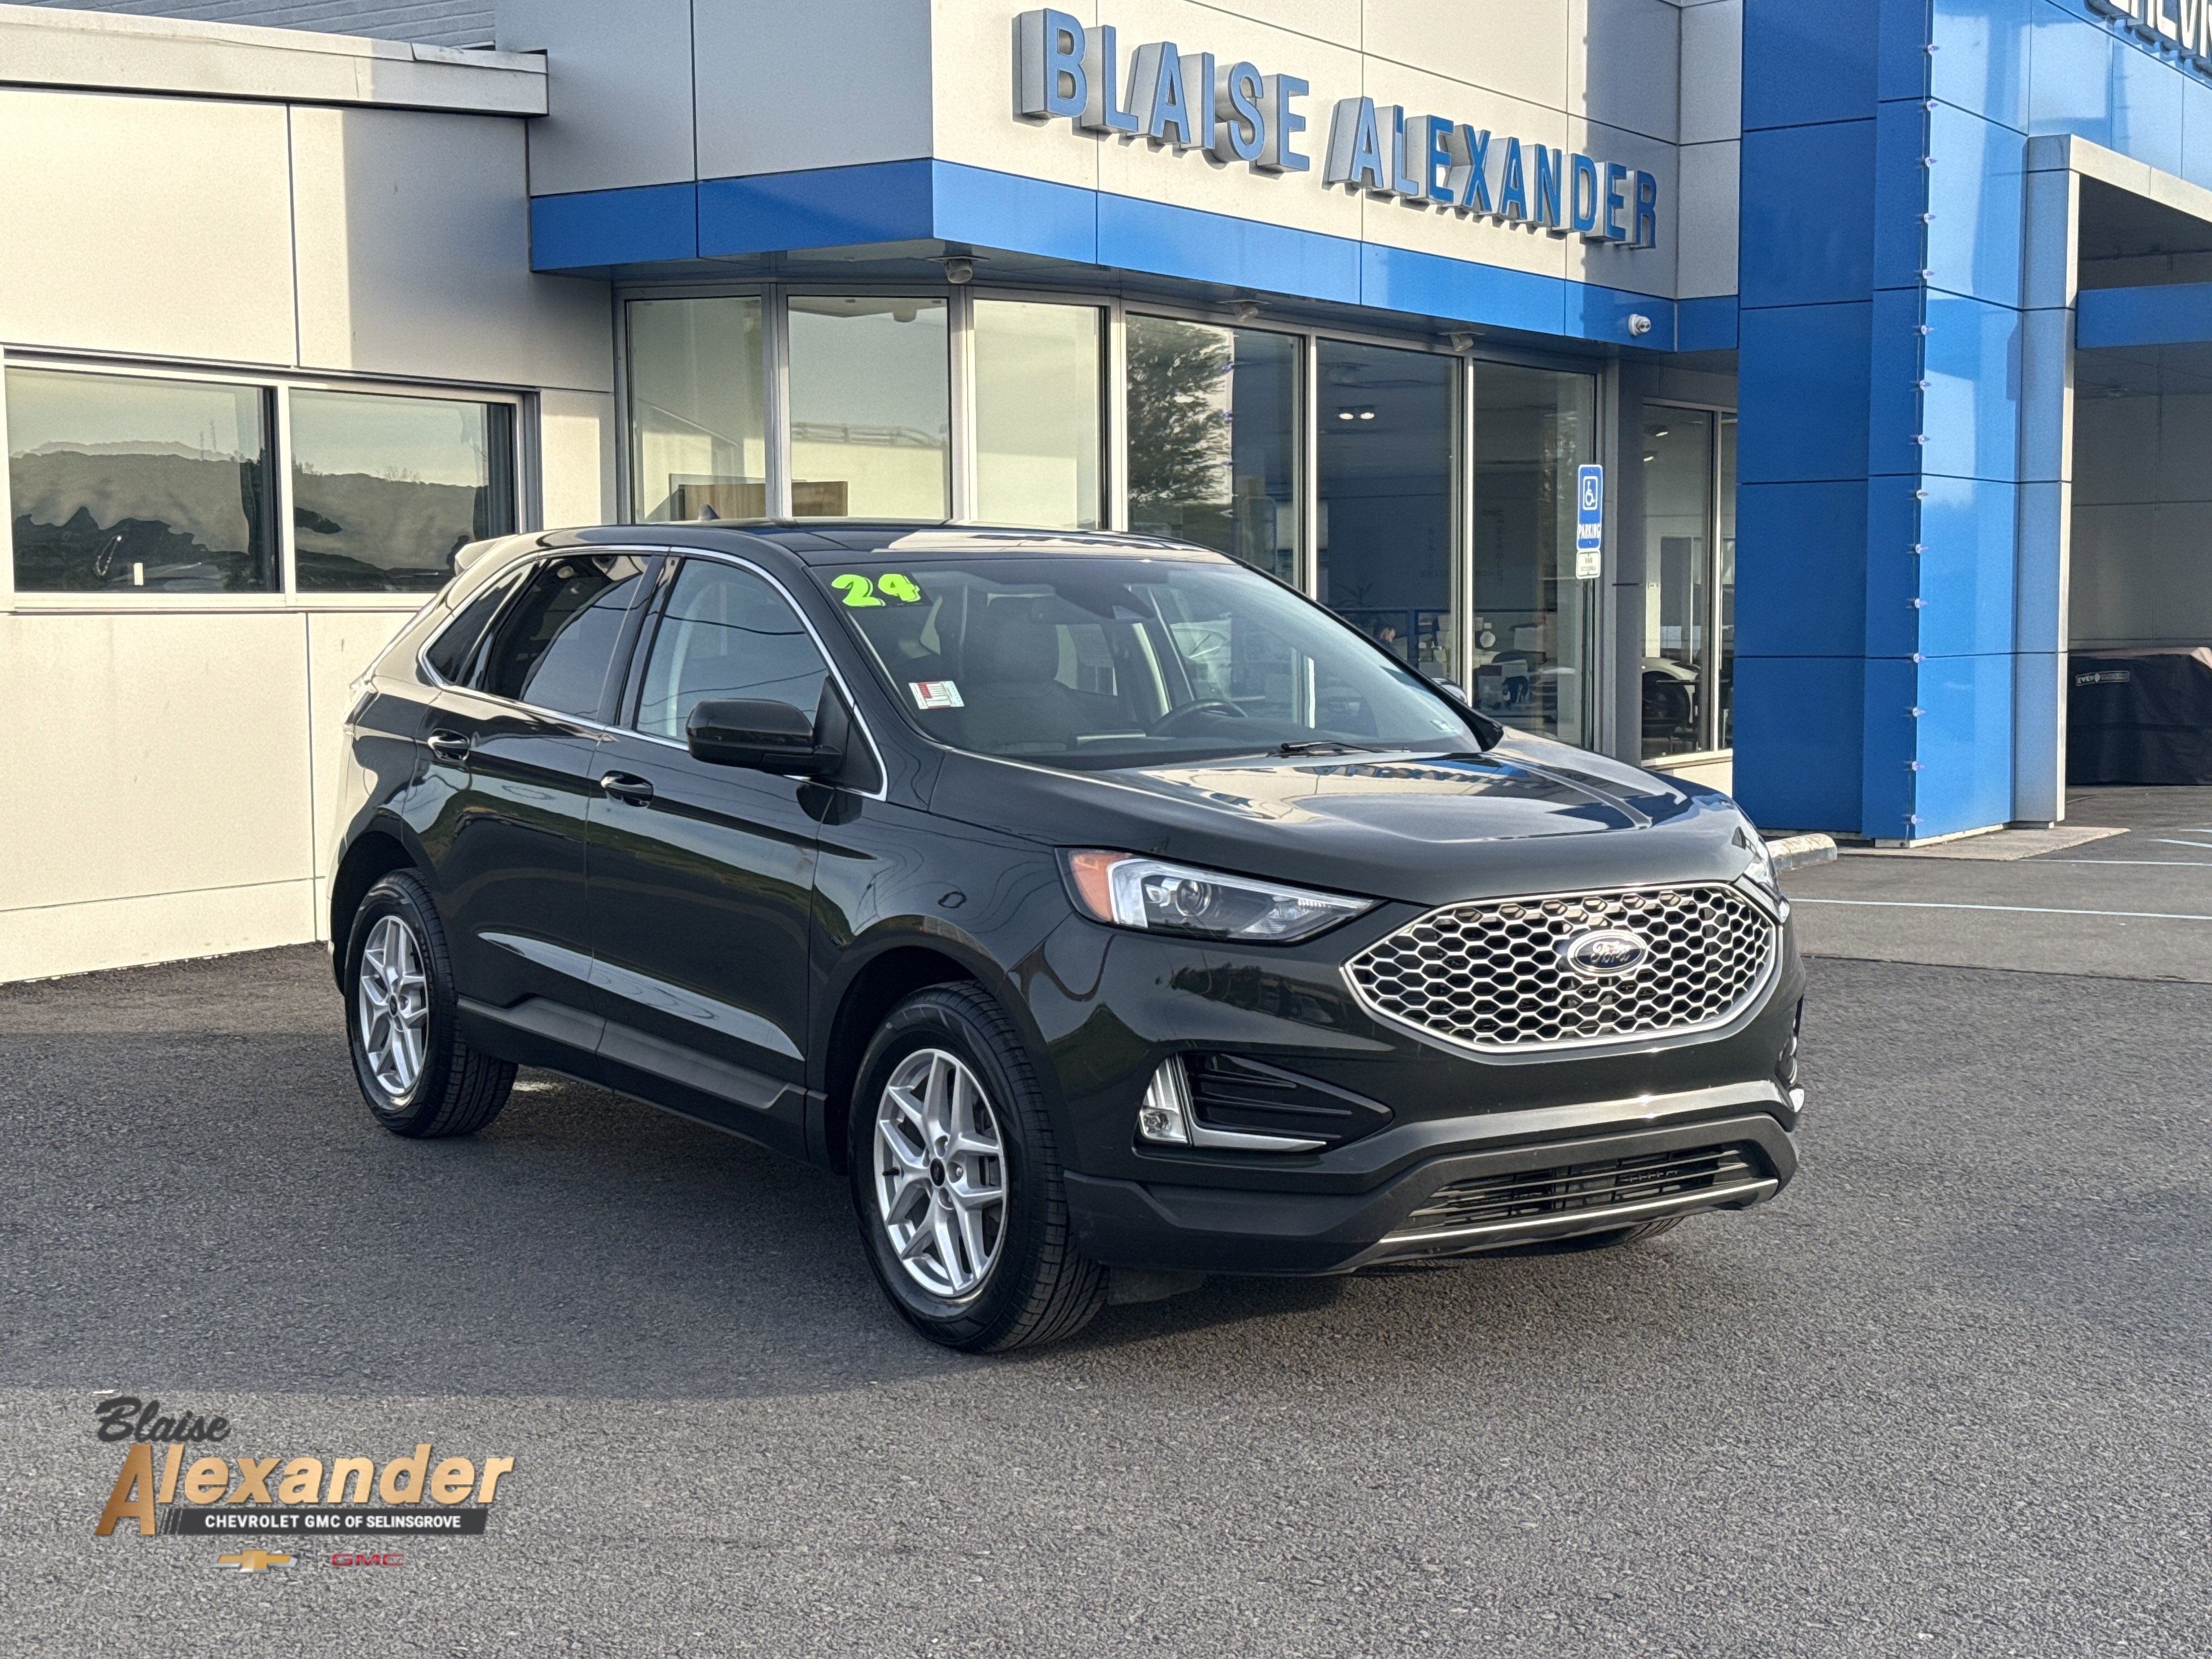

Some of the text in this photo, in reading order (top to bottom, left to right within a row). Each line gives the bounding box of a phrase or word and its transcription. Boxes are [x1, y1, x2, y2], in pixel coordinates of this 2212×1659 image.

[1025, 8, 1658, 250] BLAISE ALEXANDER
[1578, 523, 1600, 539] PARKING
[832, 573, 921, 607] 24
[1592, 940, 1632, 963] Ford
